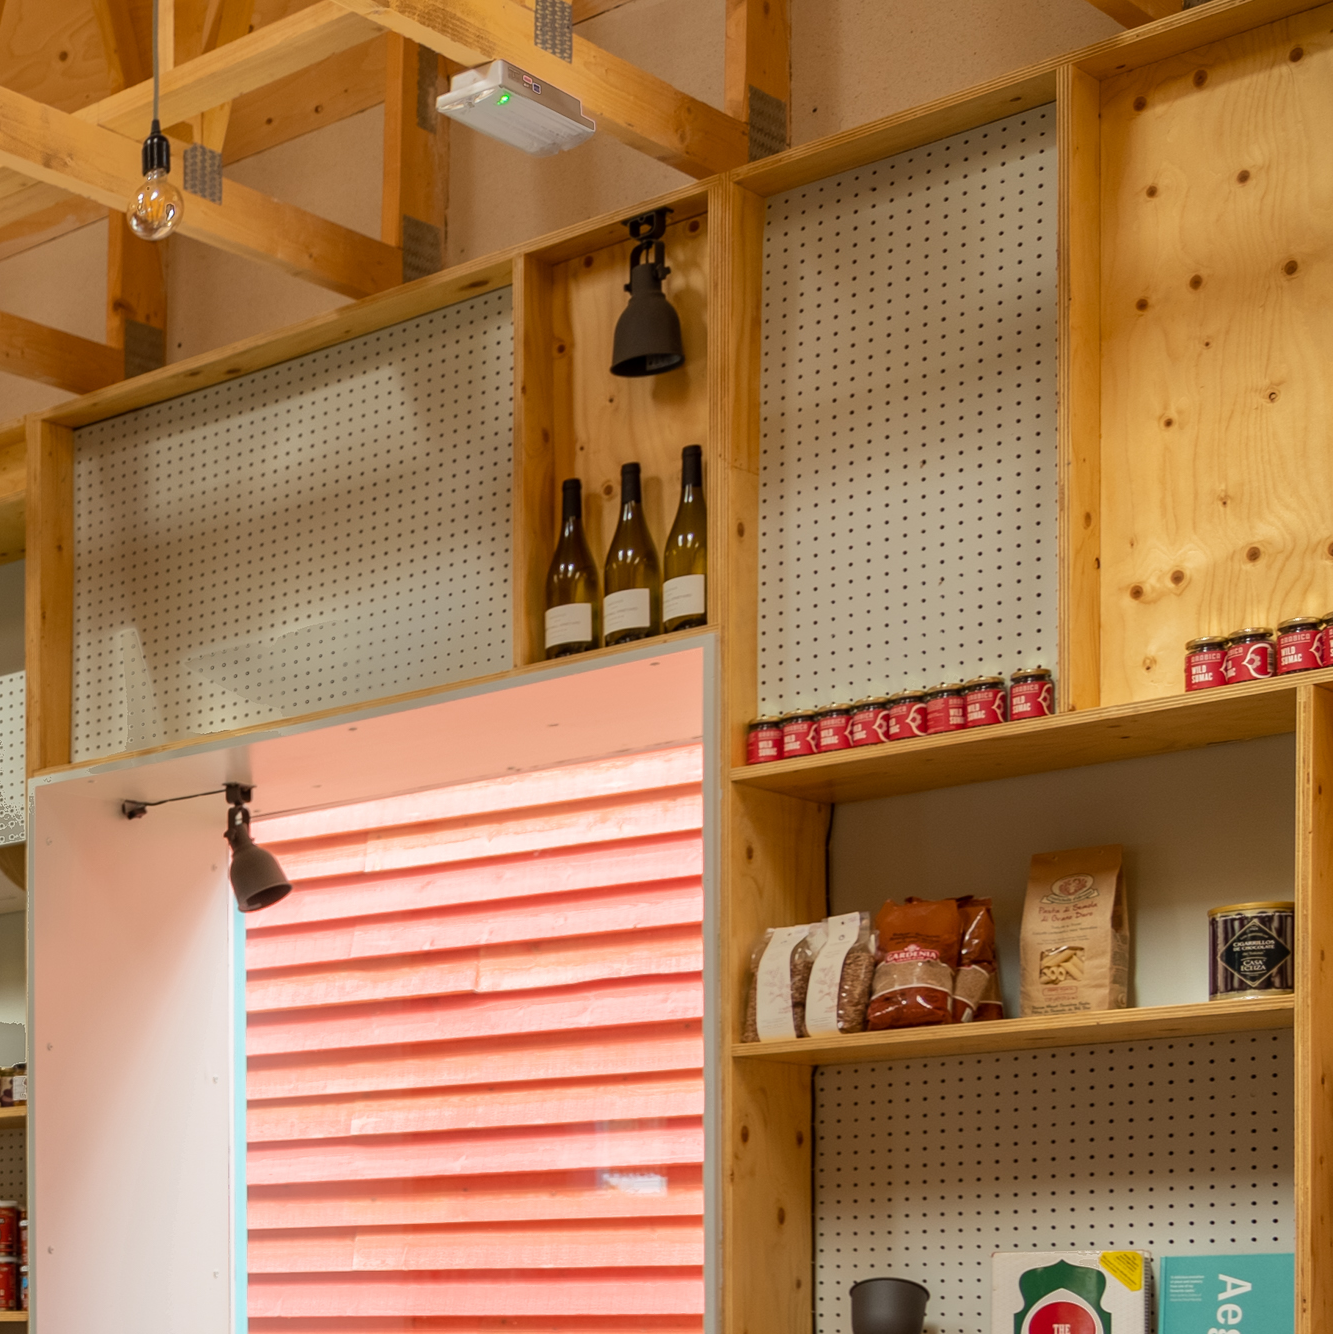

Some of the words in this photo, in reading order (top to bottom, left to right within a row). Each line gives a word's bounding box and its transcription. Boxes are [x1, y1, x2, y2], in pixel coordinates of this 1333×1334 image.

[1281, 647, 1295, 655] WILD
[1281, 654, 1302, 665] SUMAC
[1191, 665, 1207, 674] WILD
[1191, 672, 1213, 683] SUMAC
[1013, 696, 1025, 704] WILD
[1013, 703, 1031, 713] SUMAC
[887, 951, 937, 961] GARDENIA
